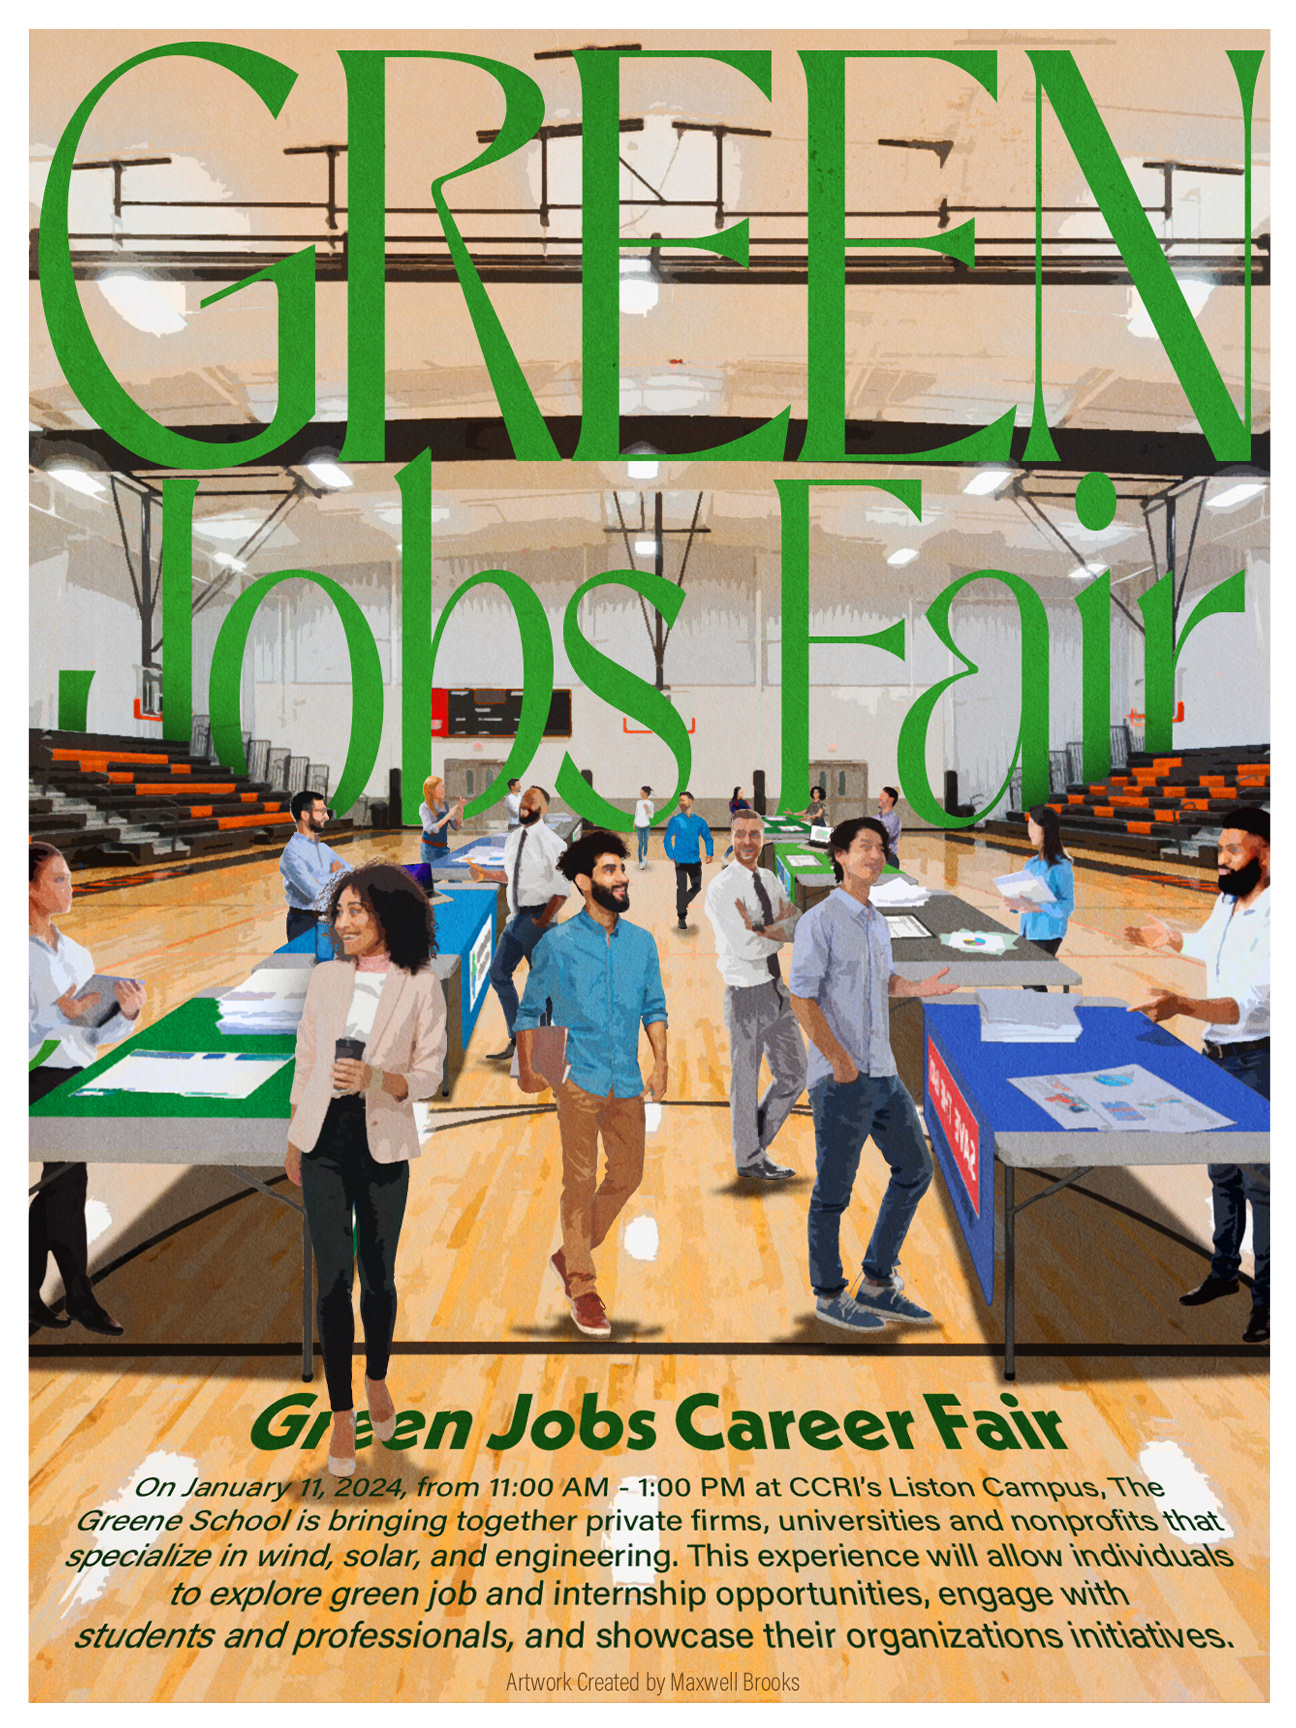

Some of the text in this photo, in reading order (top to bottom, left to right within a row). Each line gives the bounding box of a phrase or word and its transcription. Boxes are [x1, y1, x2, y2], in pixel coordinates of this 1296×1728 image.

[38, 41, 1267, 470] GREEN
[59, 446, 1245, 831] Jobs Fair
[251, 1392, 1068, 1451] Green Jobs Career Fair
[136, 1477, 175, 1496] On
[181, 1478, 292, 1502] January
[302, 1478, 324, 1499] 11,
[334, 1478, 406, 1499] 2024,
[418, 1476, 479, 1496] from
[491, 1478, 553, 1496] 11:00
[563, 1478, 608, 1496] AM
[639, 1478, 690, 1496] 1:00
[702, 1478, 744, 1496] PM
[756, 1479, 781, 1496] at
[889, 1477, 975, 1496] Liston
[983, 1477, 1105, 1502] Campus,
[1107, 1476, 1165, 1496] The
[78, 1509, 1225, 1536] Greene School is bringing together private firms, universities and nonprofits that
[65, 1543, 1233, 1573] specialize in wind, solar, and engineering. This experience will allow individuals
[171, 1580, 1129, 1612] to explore green job and internship opportunities, engage with
[75, 1621, 1233, 1655] students and professionals, and showcase their organizations initiatives.
[506, 1672, 799, 1696] Artwork Created by Maxwell Brooks
